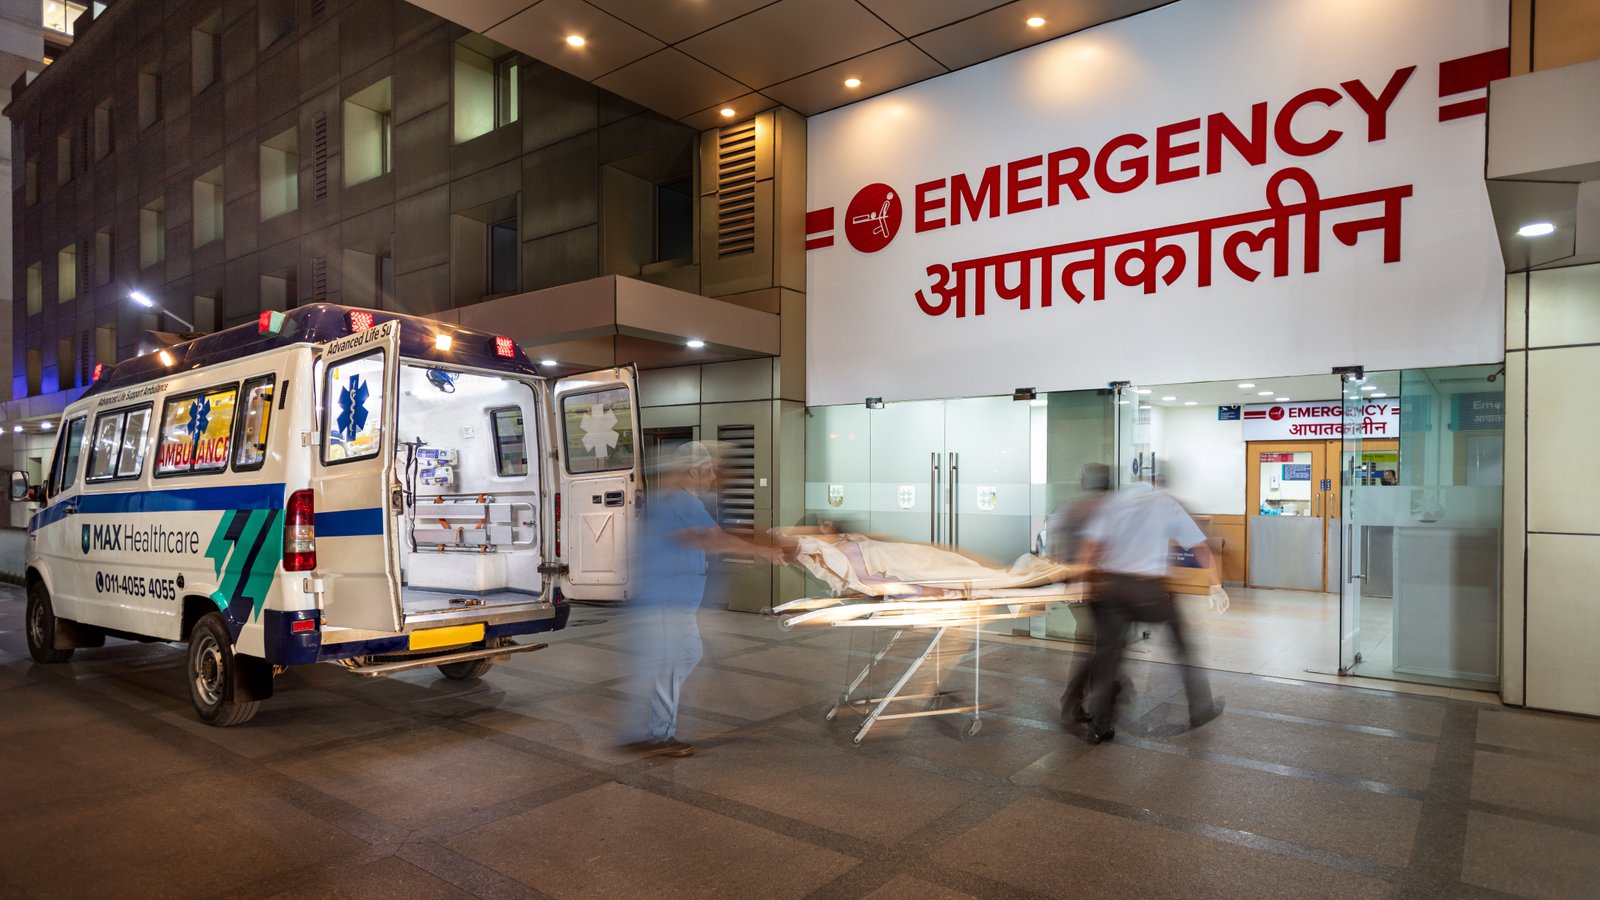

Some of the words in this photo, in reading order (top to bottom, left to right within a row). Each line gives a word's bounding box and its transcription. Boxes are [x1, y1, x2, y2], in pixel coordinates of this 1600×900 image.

[915, 65, 1417, 233] EMERGENCY
[915, 167, 1413, 318] आपातकालीन
[327, 332, 365, 356] Advanced
[365, 327, 379, 343] Life
[98, 395, 118, 406] Advanced
[126, 389, 143, 400] Support
[143, 383, 169, 396] Ambulance
[158, 436, 230, 467] AMBULANCE
[93, 524, 122, 551] MAX
[124, 524, 200, 554] Healthcare
[105, 573, 146, 597] 011-4055
[148, 578, 176, 601] 4055
